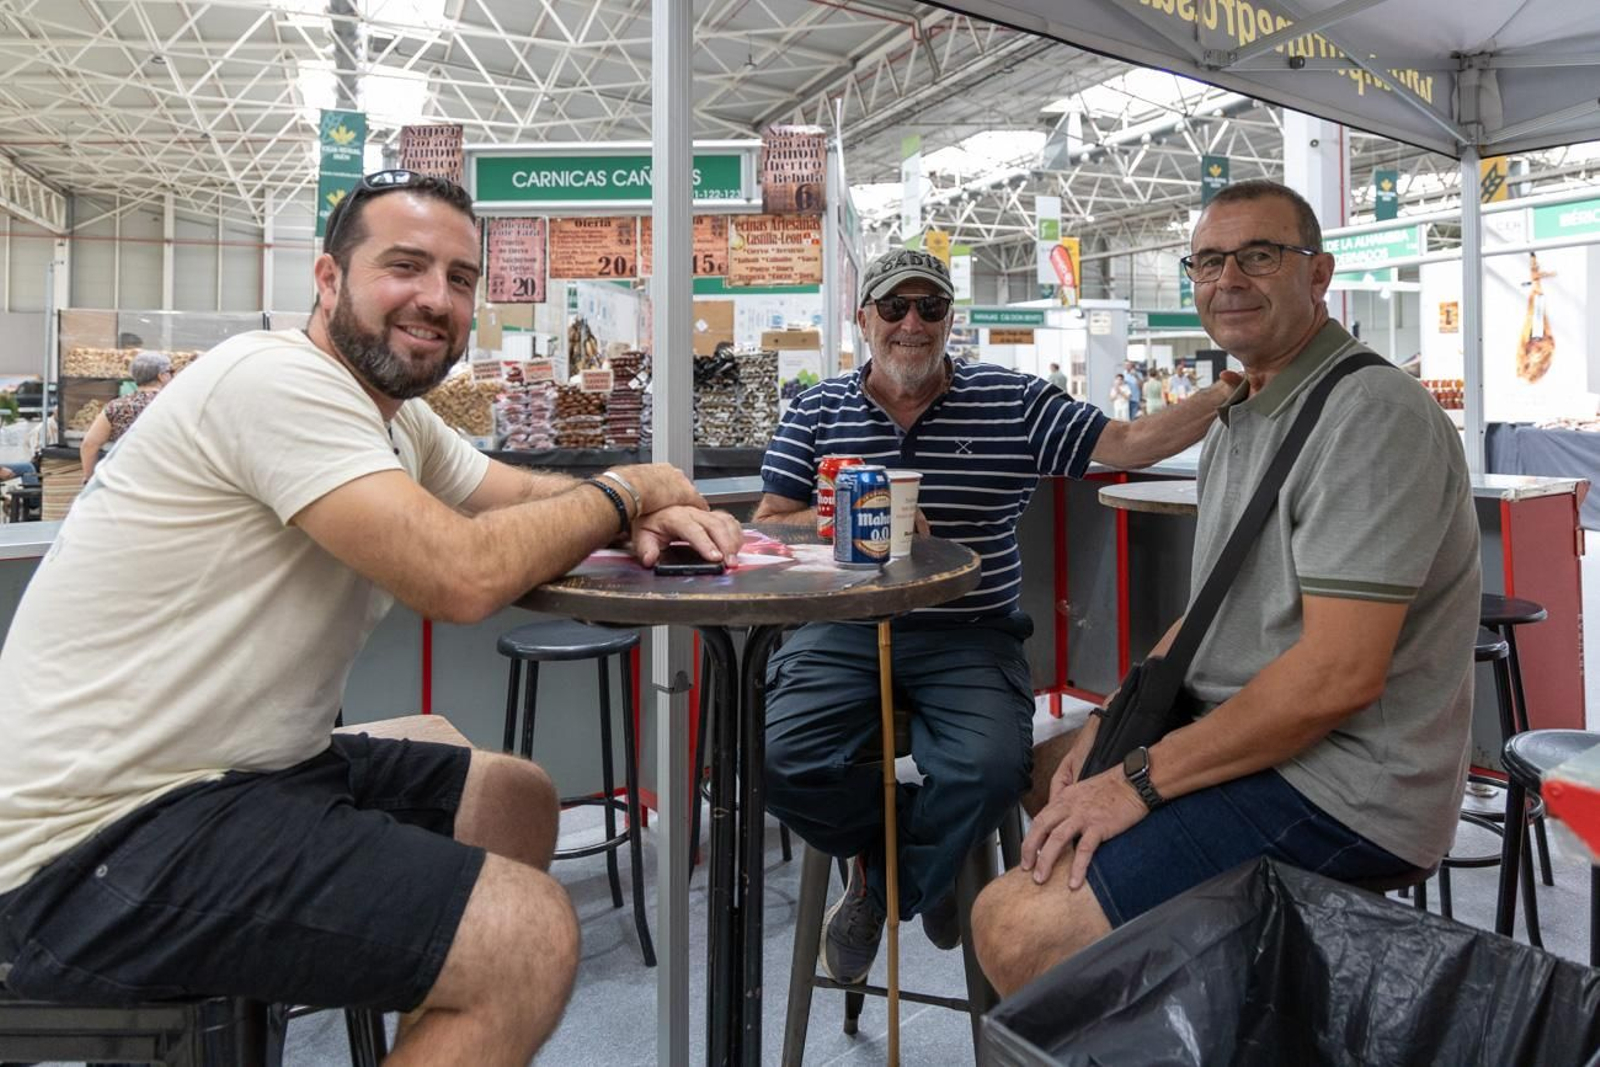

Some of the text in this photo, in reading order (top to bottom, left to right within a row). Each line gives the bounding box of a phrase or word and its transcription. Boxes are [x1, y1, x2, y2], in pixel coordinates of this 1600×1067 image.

[512, 165, 701, 188] CARNICAS CAÑS
[693, 189, 741, 199] 1-122-123
[598, 255, 627, 276] 20
[512, 277, 536, 297] 20
